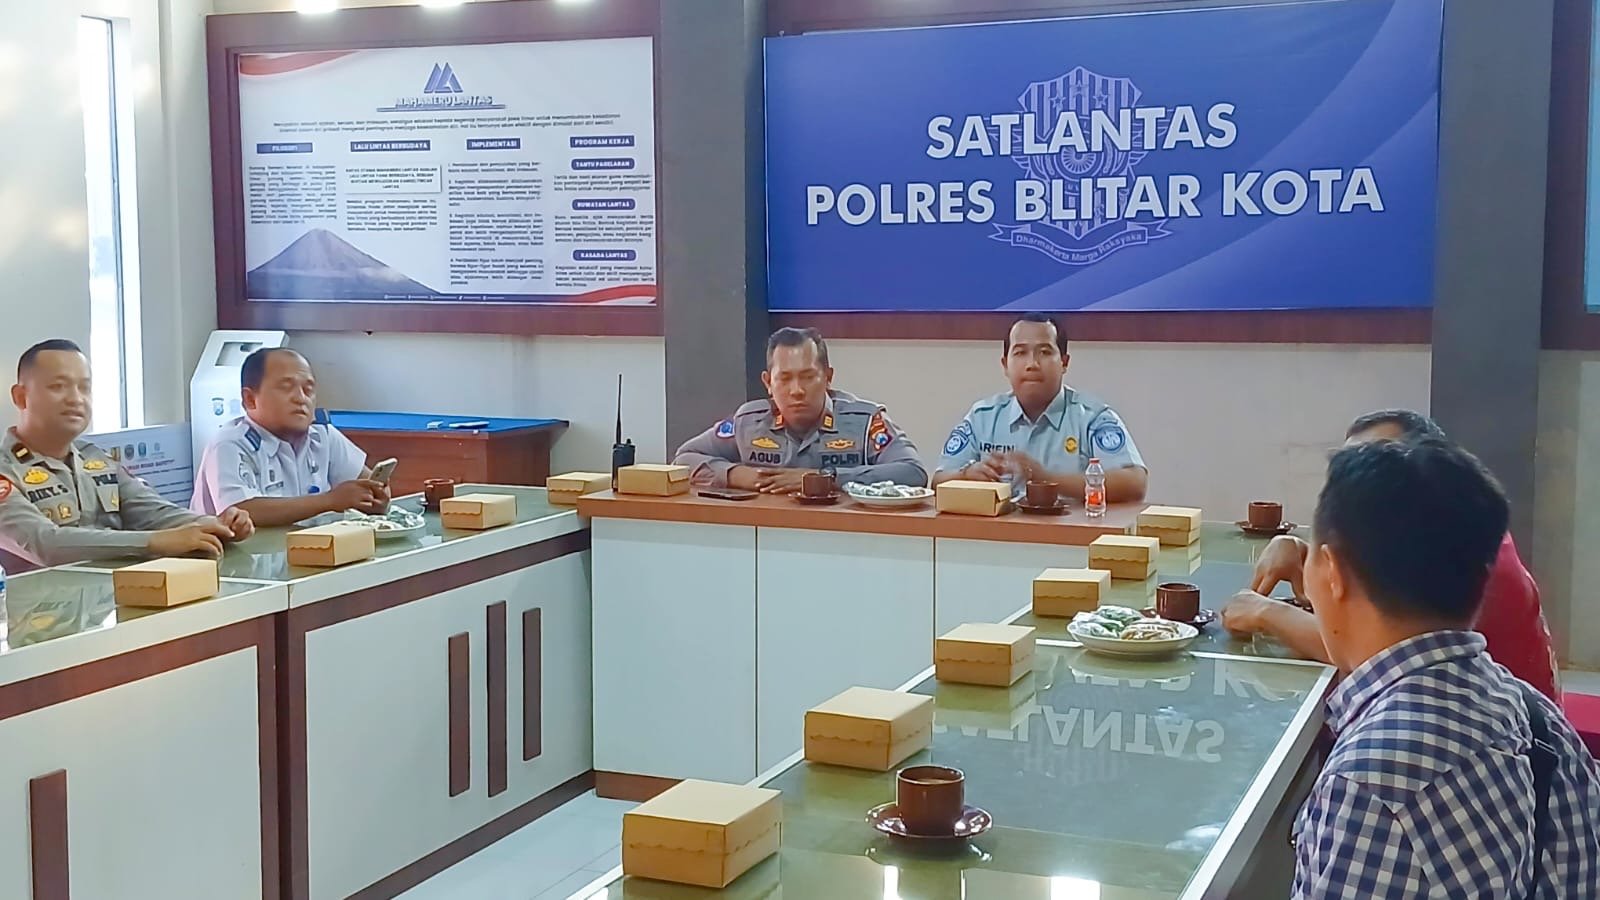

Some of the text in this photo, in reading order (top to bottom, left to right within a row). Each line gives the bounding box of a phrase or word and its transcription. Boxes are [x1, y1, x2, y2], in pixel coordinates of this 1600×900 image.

[926, 102, 1237, 159] SATLANTAS
[471, 140, 517, 148] IMPLEMENTASI
[806, 167, 1384, 226] POLRES BLITAR KOTA
[1071, 251, 1099, 263] Marga
[821, 453, 860, 466] POLRI
